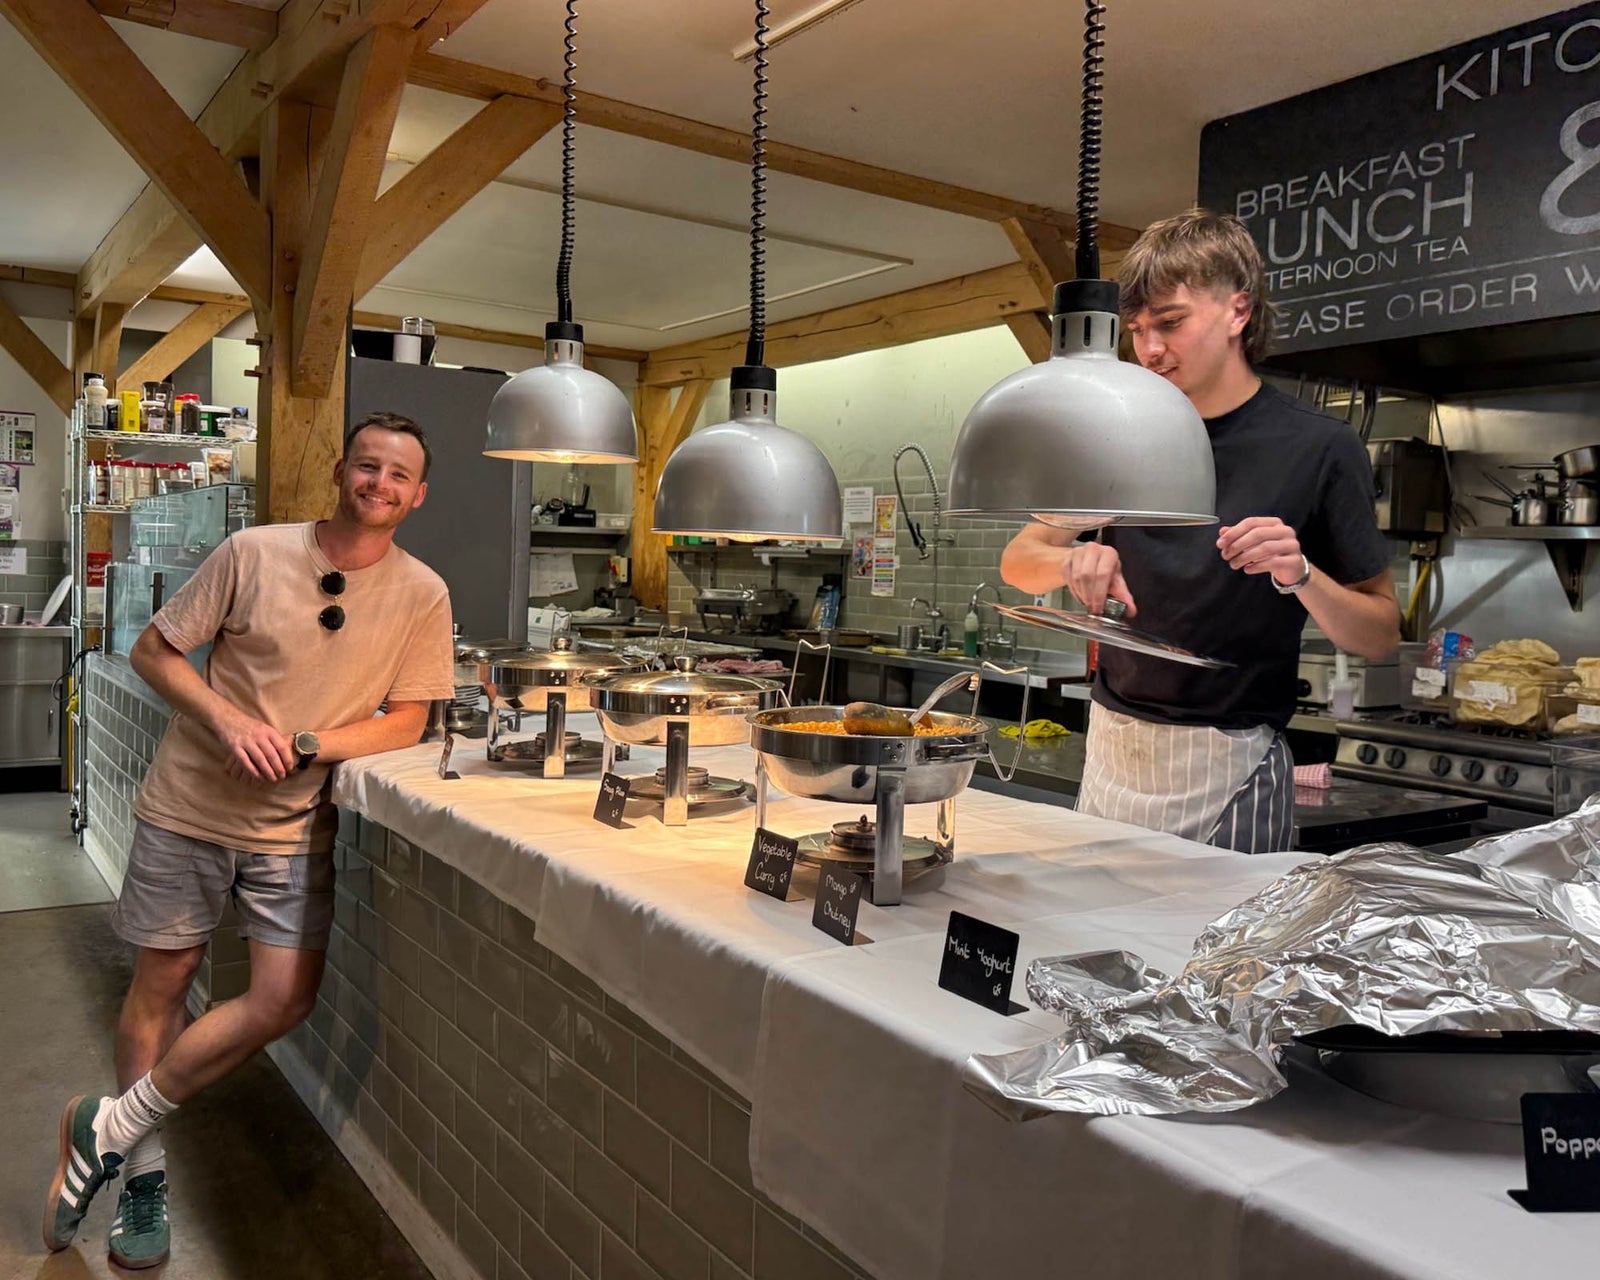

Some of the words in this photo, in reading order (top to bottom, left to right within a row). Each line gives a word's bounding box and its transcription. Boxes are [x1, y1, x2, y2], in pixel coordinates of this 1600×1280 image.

[1236, 132, 1477, 221] BREAKFAST
[1267, 171, 1474, 265] UNCH
[1264, 246, 1398, 292] TERNOON
[1411, 235, 1470, 265] TEA
[1271, 300, 1367, 340] EASE
[1386, 273, 1537, 323] ORDER
[758, 834, 793, 863] Vegetable
[825, 874, 848, 901] Mango
[823, 900, 851, 938] Chutney
[948, 935, 971, 960] Mint
[976, 947, 1012, 978] Yoghurt
